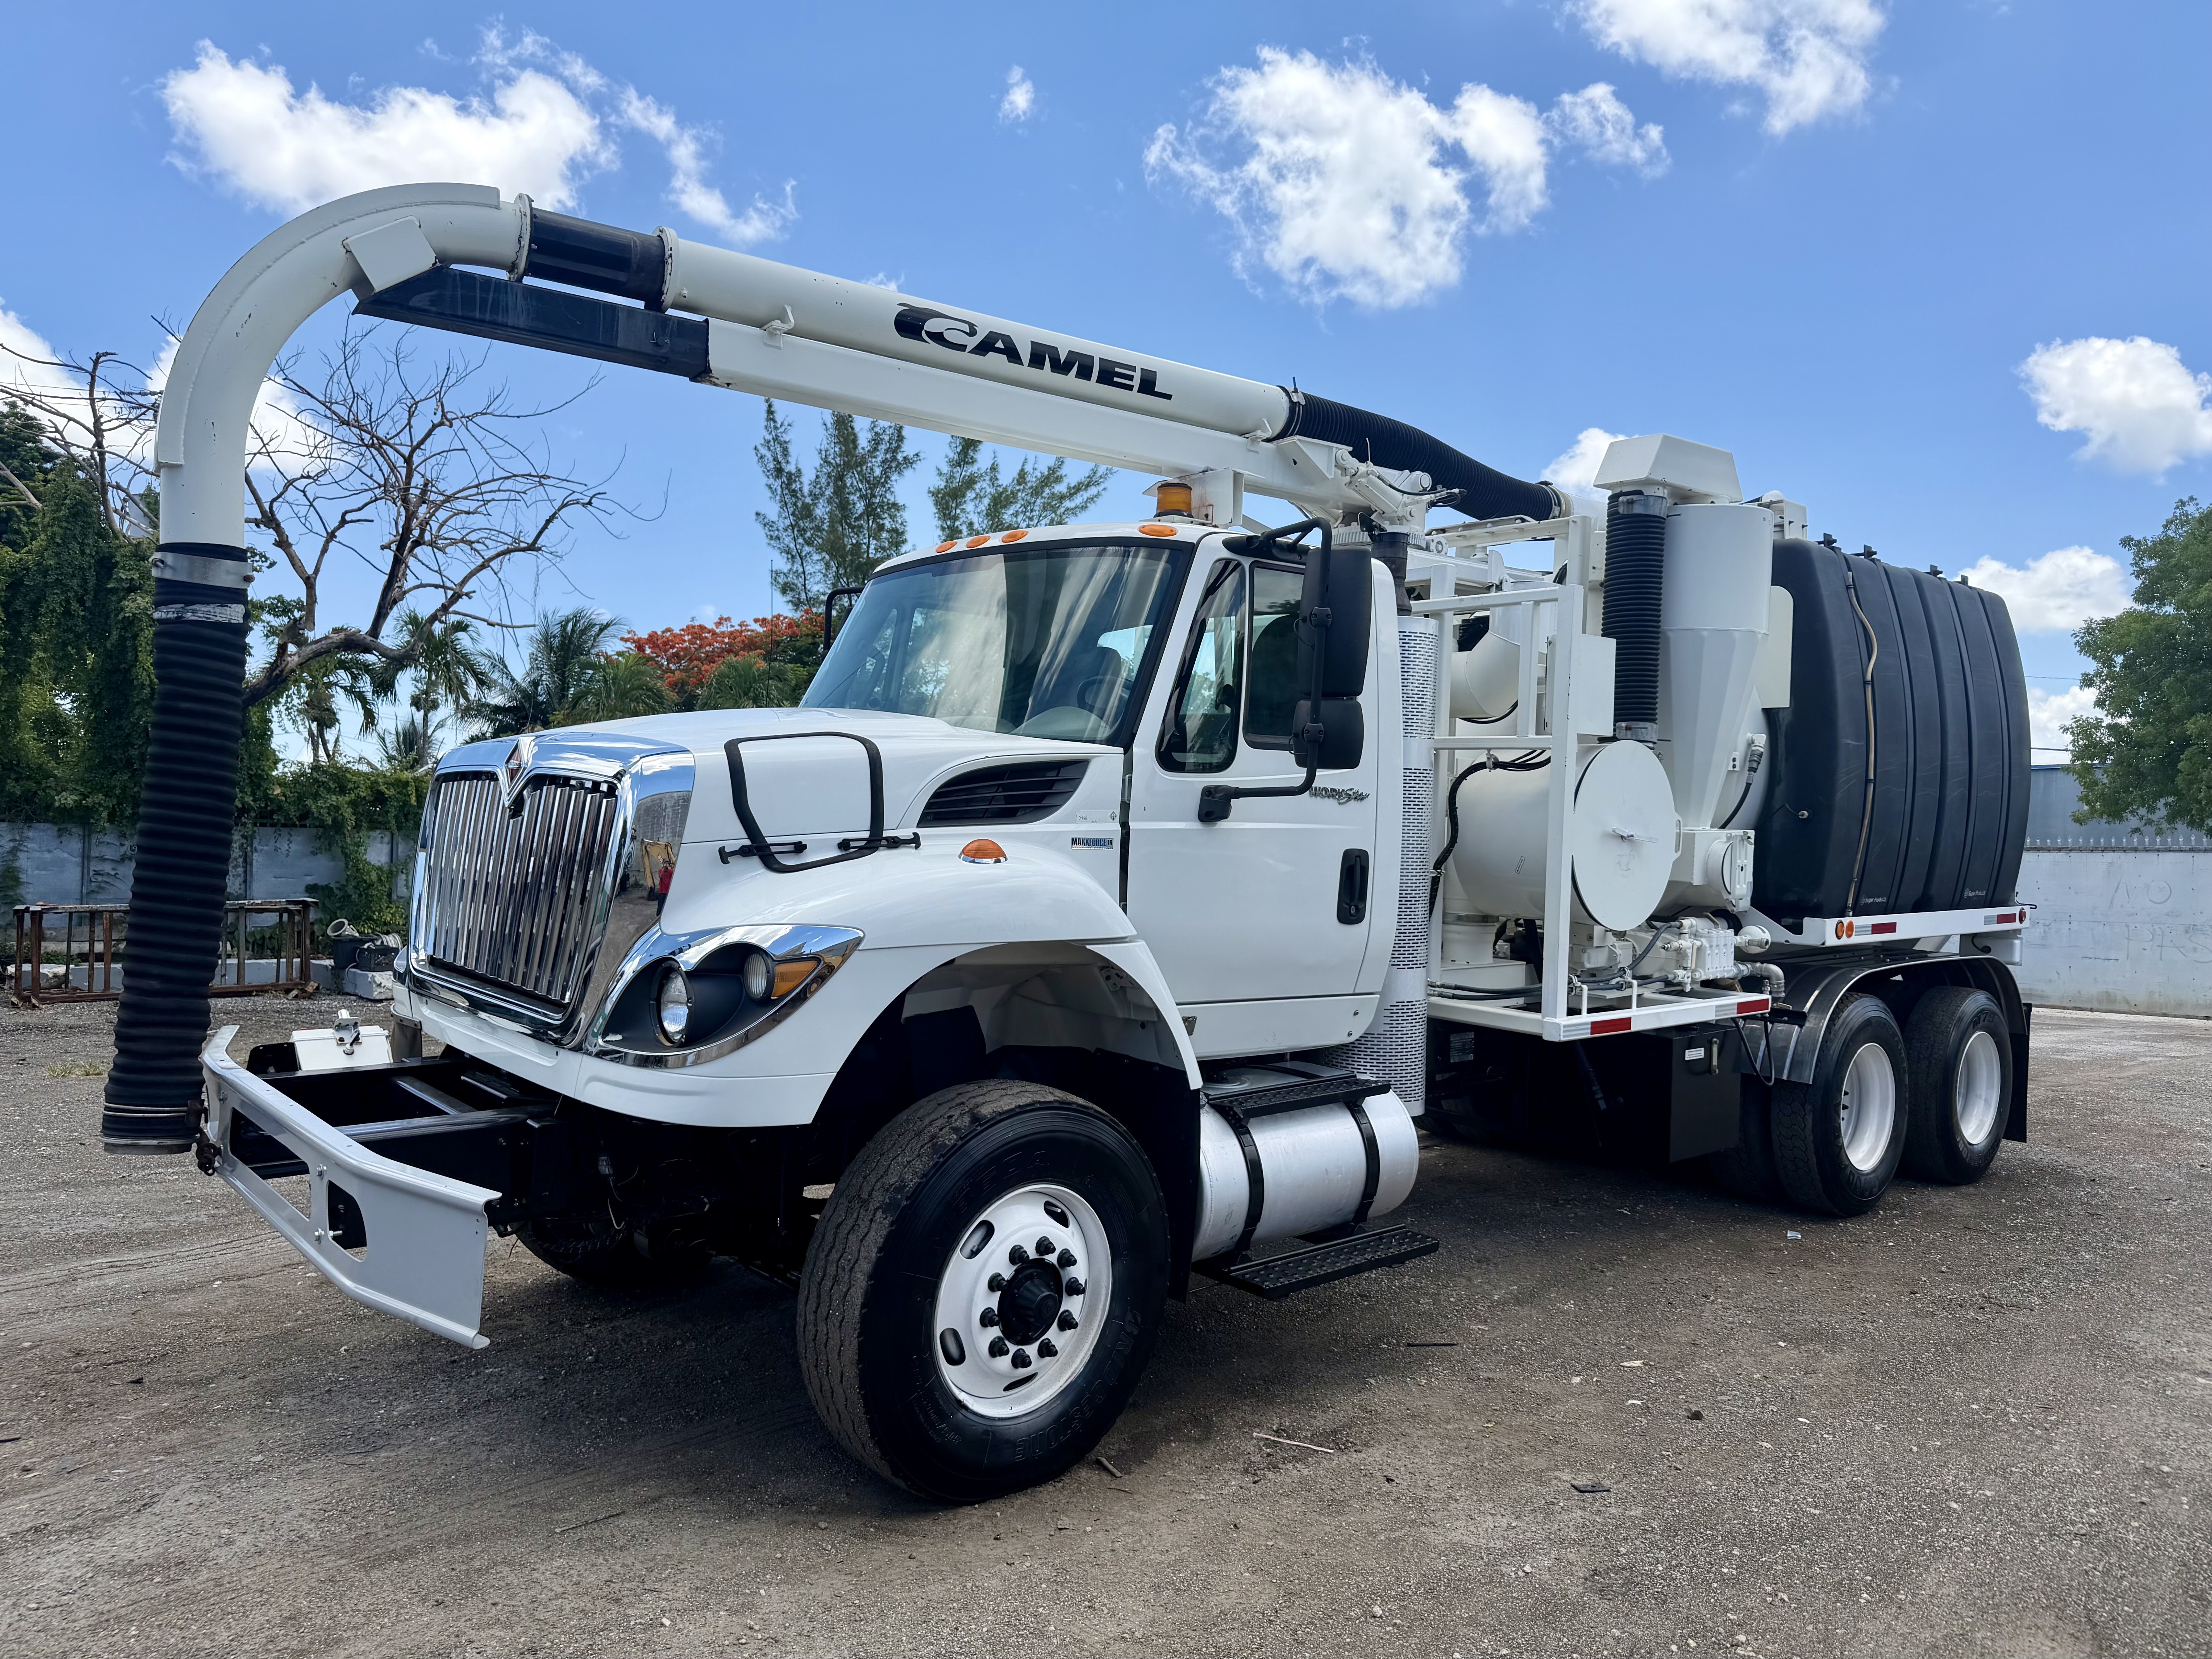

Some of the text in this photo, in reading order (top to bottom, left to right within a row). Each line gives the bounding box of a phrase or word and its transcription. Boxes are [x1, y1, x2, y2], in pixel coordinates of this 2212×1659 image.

[894, 302, 1173, 401] CAMEL
[1072, 838, 1106, 847] MAXXFORCE
[1015, 1306, 1142, 1462] BRIDGESTONE
